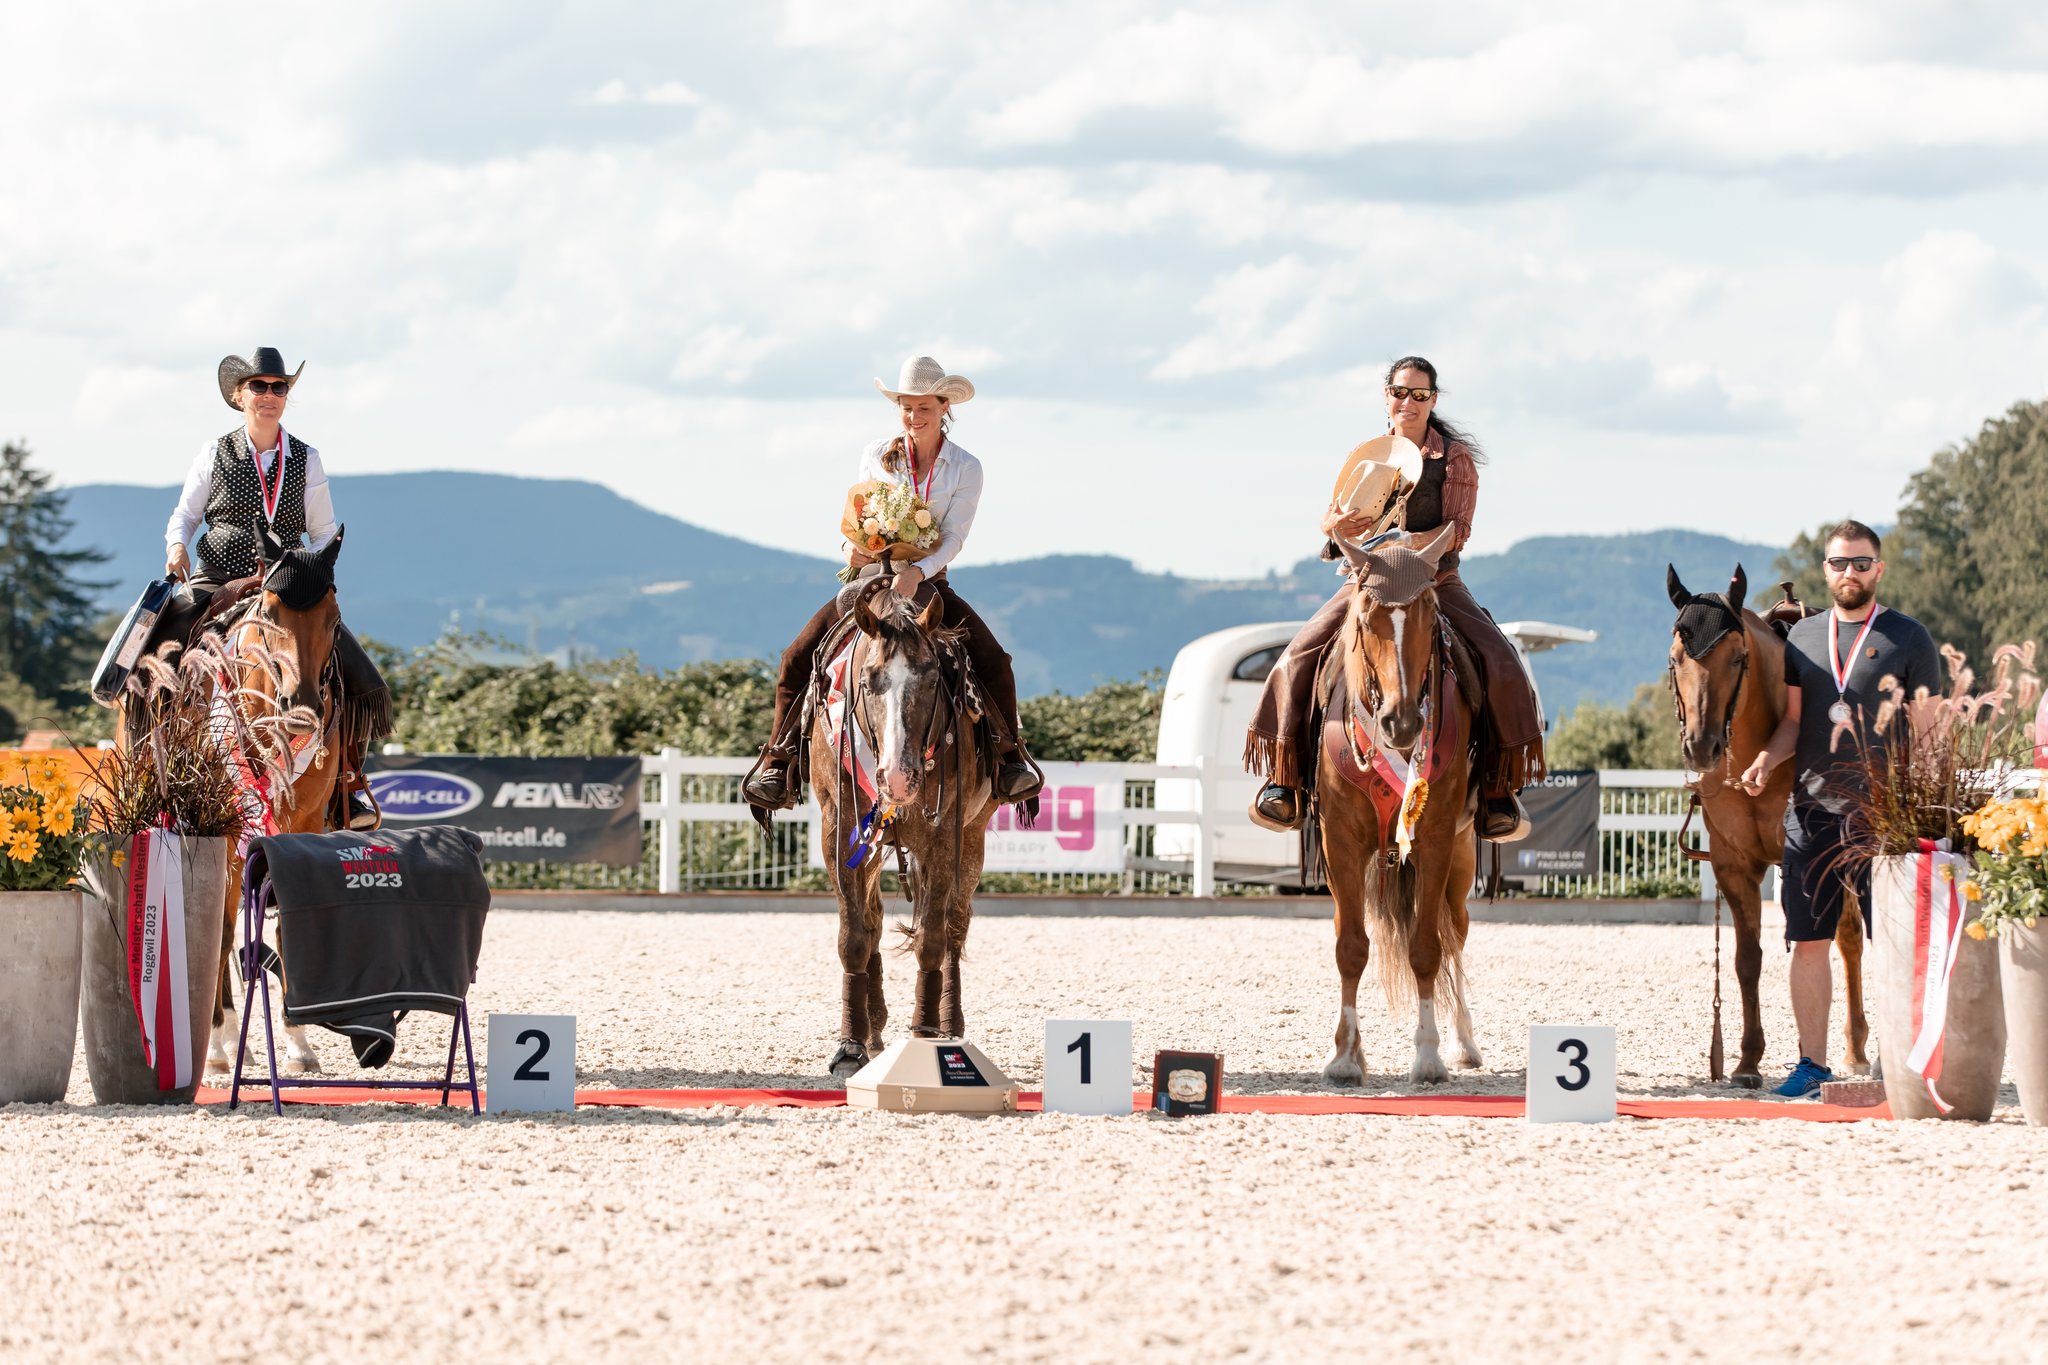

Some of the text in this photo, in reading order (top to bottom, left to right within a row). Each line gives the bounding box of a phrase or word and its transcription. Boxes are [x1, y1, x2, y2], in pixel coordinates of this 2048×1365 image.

[134, 834, 148, 882] Western
[479, 827, 567, 847] micell.de
[1537, 851, 1585, 860] FIND US ON
[341, 860, 400, 874] WESTERN
[345, 873, 403, 889] 2023
[1537, 860, 1585, 869] FACEBOOK
[131, 883, 145, 964] Meisterschaft
[143, 905, 157, 983] Roggwil 2023
[513, 1029, 551, 1081] 2
[1067, 1032, 1092, 1085] 1
[1556, 1038, 1591, 1092] 3
